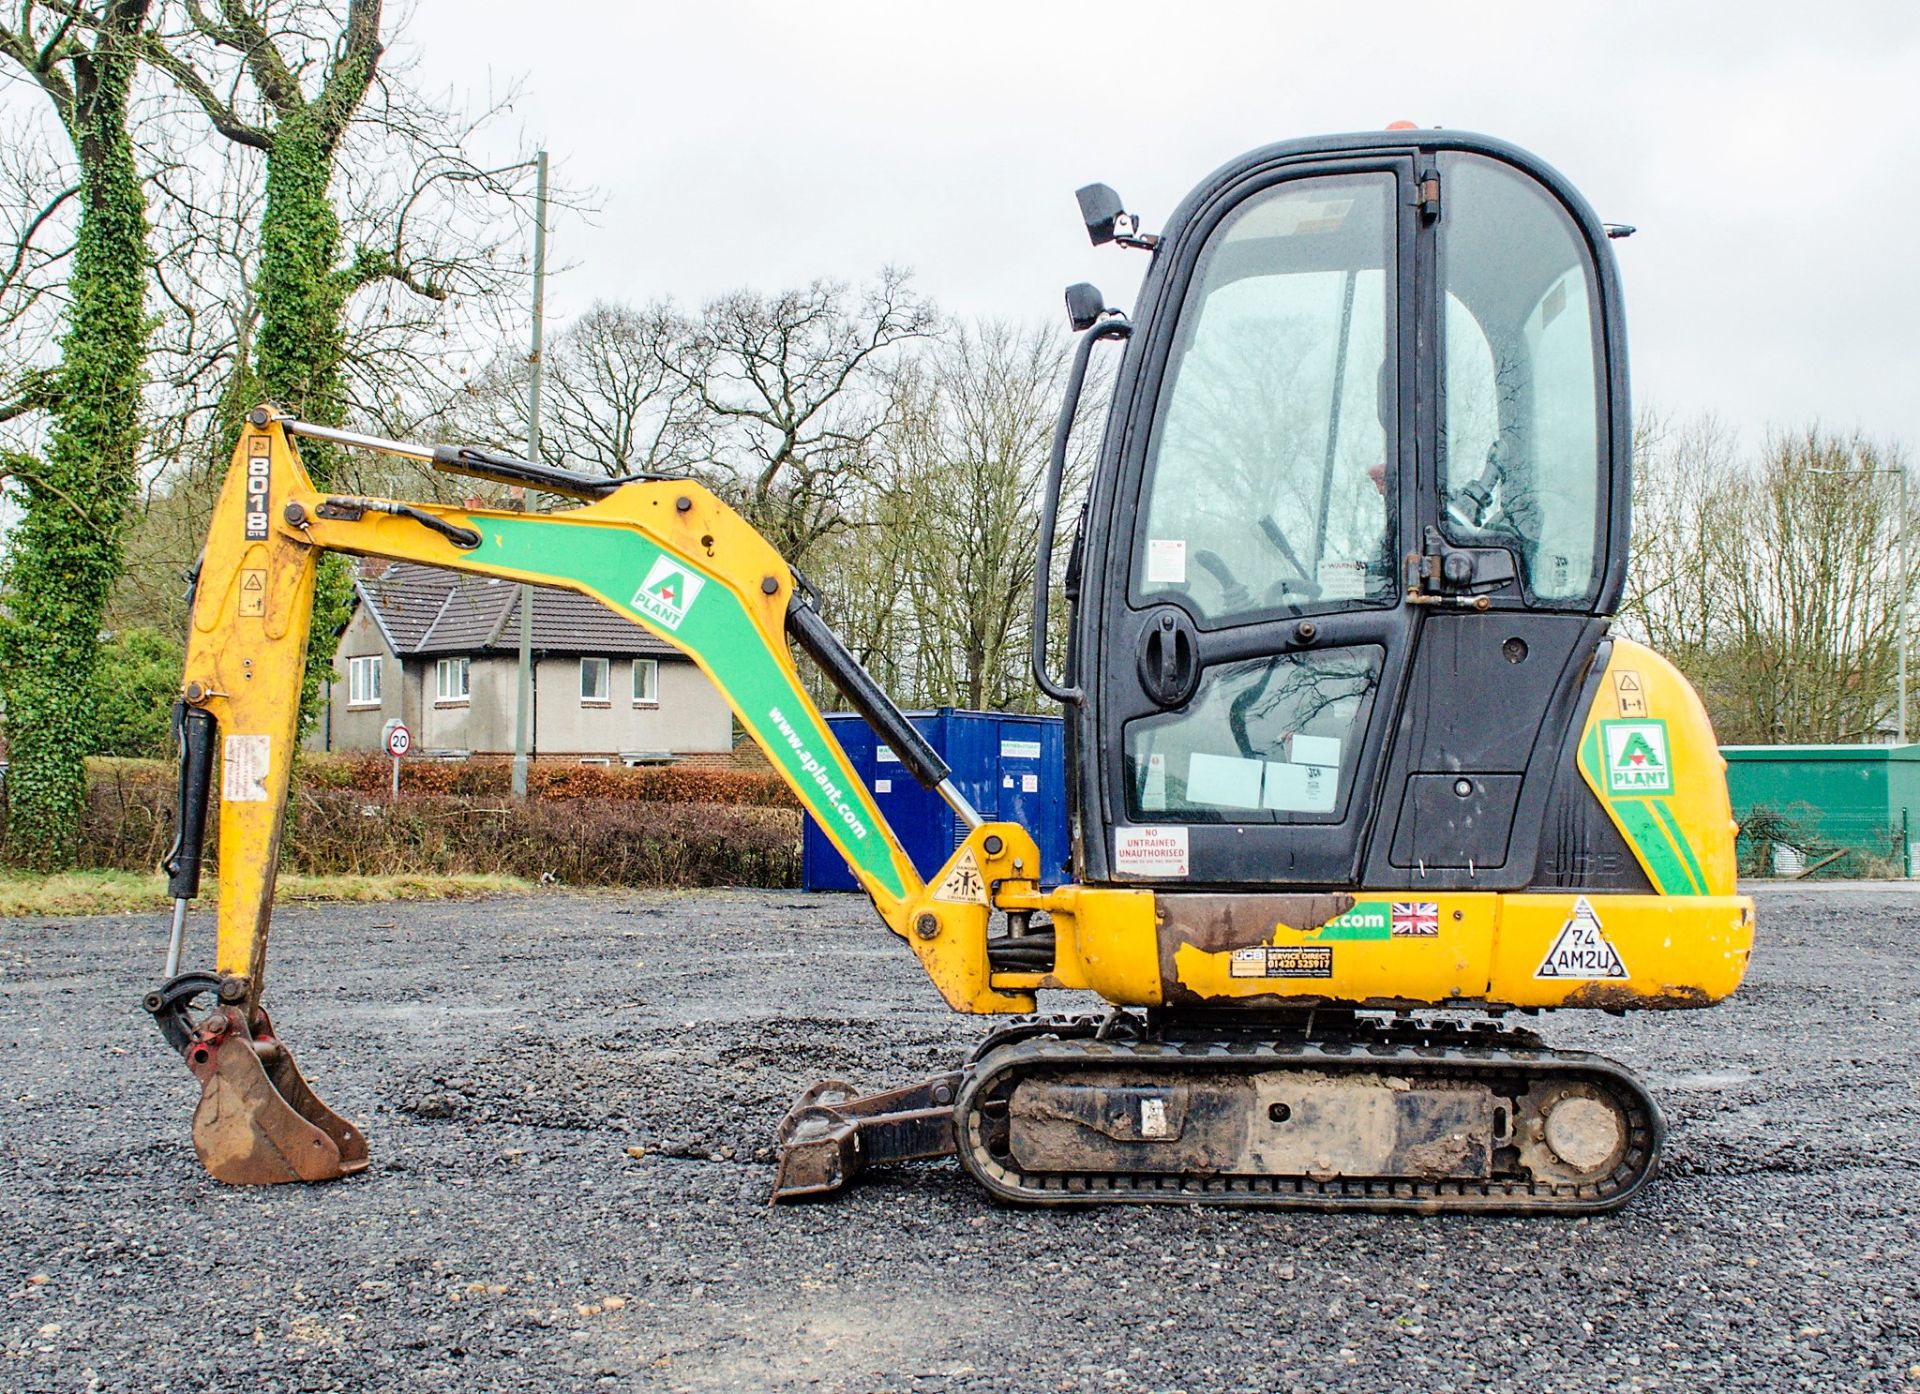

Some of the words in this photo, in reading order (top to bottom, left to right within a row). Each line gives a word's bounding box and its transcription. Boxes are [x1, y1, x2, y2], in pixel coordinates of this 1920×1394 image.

[248, 457, 269, 530] 8018
[635, 592, 681, 625] PLANT
[392, 735, 407, 748] 20
[768, 706, 867, 840] www.aplant.com
[1614, 772, 1665, 785] PLANT
[1145, 829, 1158, 837] NO
[1127, 839, 1176, 848] UNTRAINED
[1119, 849, 1184, 858] UNAUTHORISED
[1572, 929, 1595, 946] 74
[1235, 951, 1263, 960] JCB
[1558, 951, 1609, 969] AM2U
[1268, 960, 1296, 968] 01420
[1297, 960, 1331, 968] 525917
